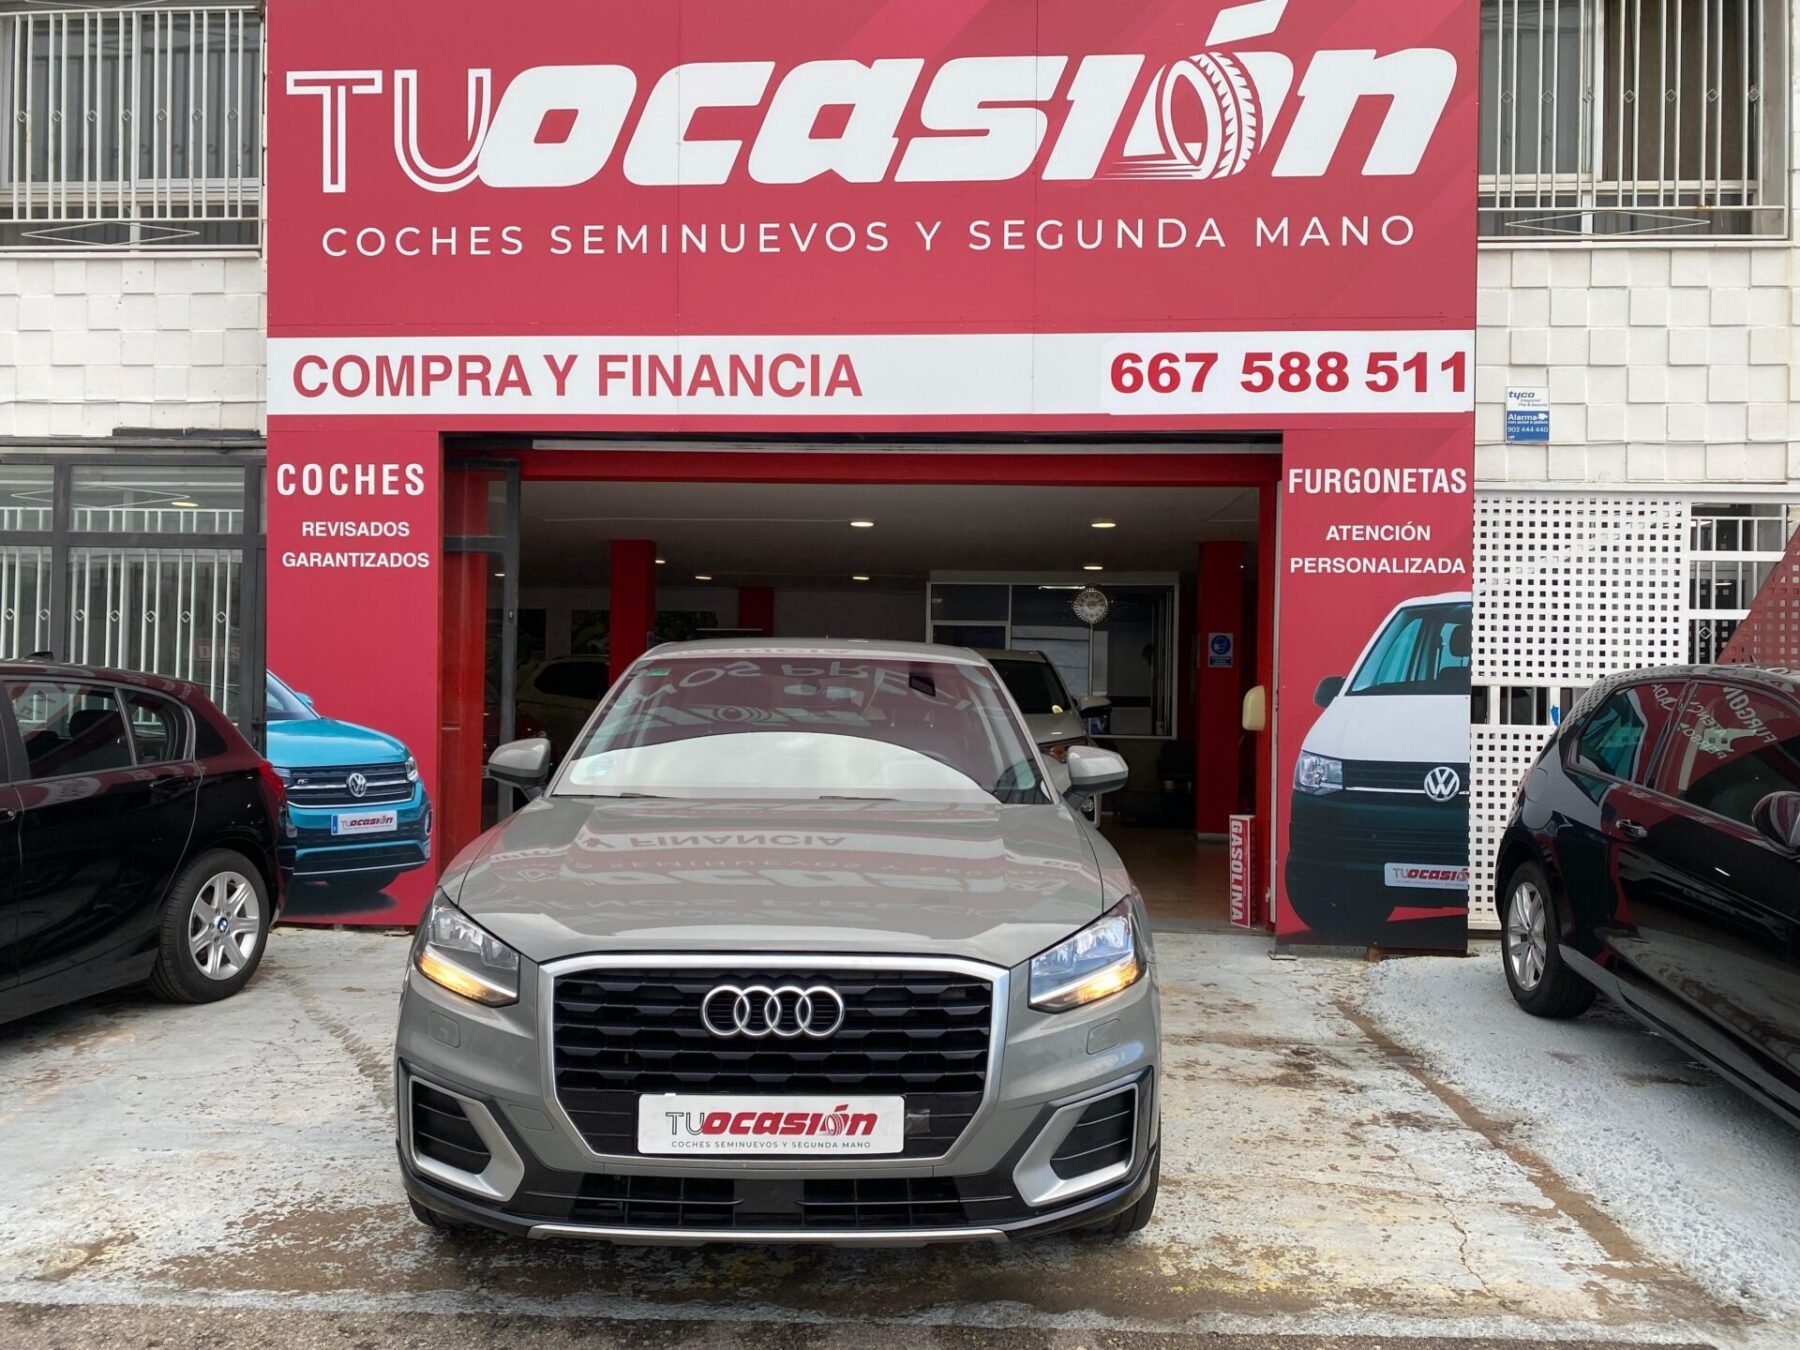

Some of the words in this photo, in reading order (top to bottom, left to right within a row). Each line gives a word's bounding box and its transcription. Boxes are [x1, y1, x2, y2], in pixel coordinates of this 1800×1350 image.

[322, 226, 525, 257] COCHES
[549, 221, 888, 255] SEMINUEVOS
[915, 220, 942, 252] Y
[968, 217, 1226, 251] SEGUNDA
[1255, 214, 1415, 248] MANO
[292, 354, 532, 398] COMPRA
[543, 354, 578, 397] Y
[597, 353, 864, 398] FINANCIA
[1110, 352, 1219, 394] 667
[1240, 351, 1350, 393] 588
[1364, 350, 1467, 393] 511
[1508, 391, 1535, 399] tyco
[276, 463, 425, 496] COCHES
[1288, 467, 1467, 494] FURGONETAS
[302, 521, 410, 537] REVISADOS
[1325, 521, 1431, 541] ATENCIÓN
[282, 552, 430, 568] GARANTIZADOS
[1290, 557, 1466, 574] PERSONALIZADA
[1230, 819, 1243, 921] GASOLINA
[671, 1140, 711, 1149] COCHES
[714, 1140, 779, 1149] SEMINUEVOS
[782, 1140, 788, 1149] Y
[791, 1140, 839, 1149] SEGUNDA
[842, 1140, 871, 1149] MANO
